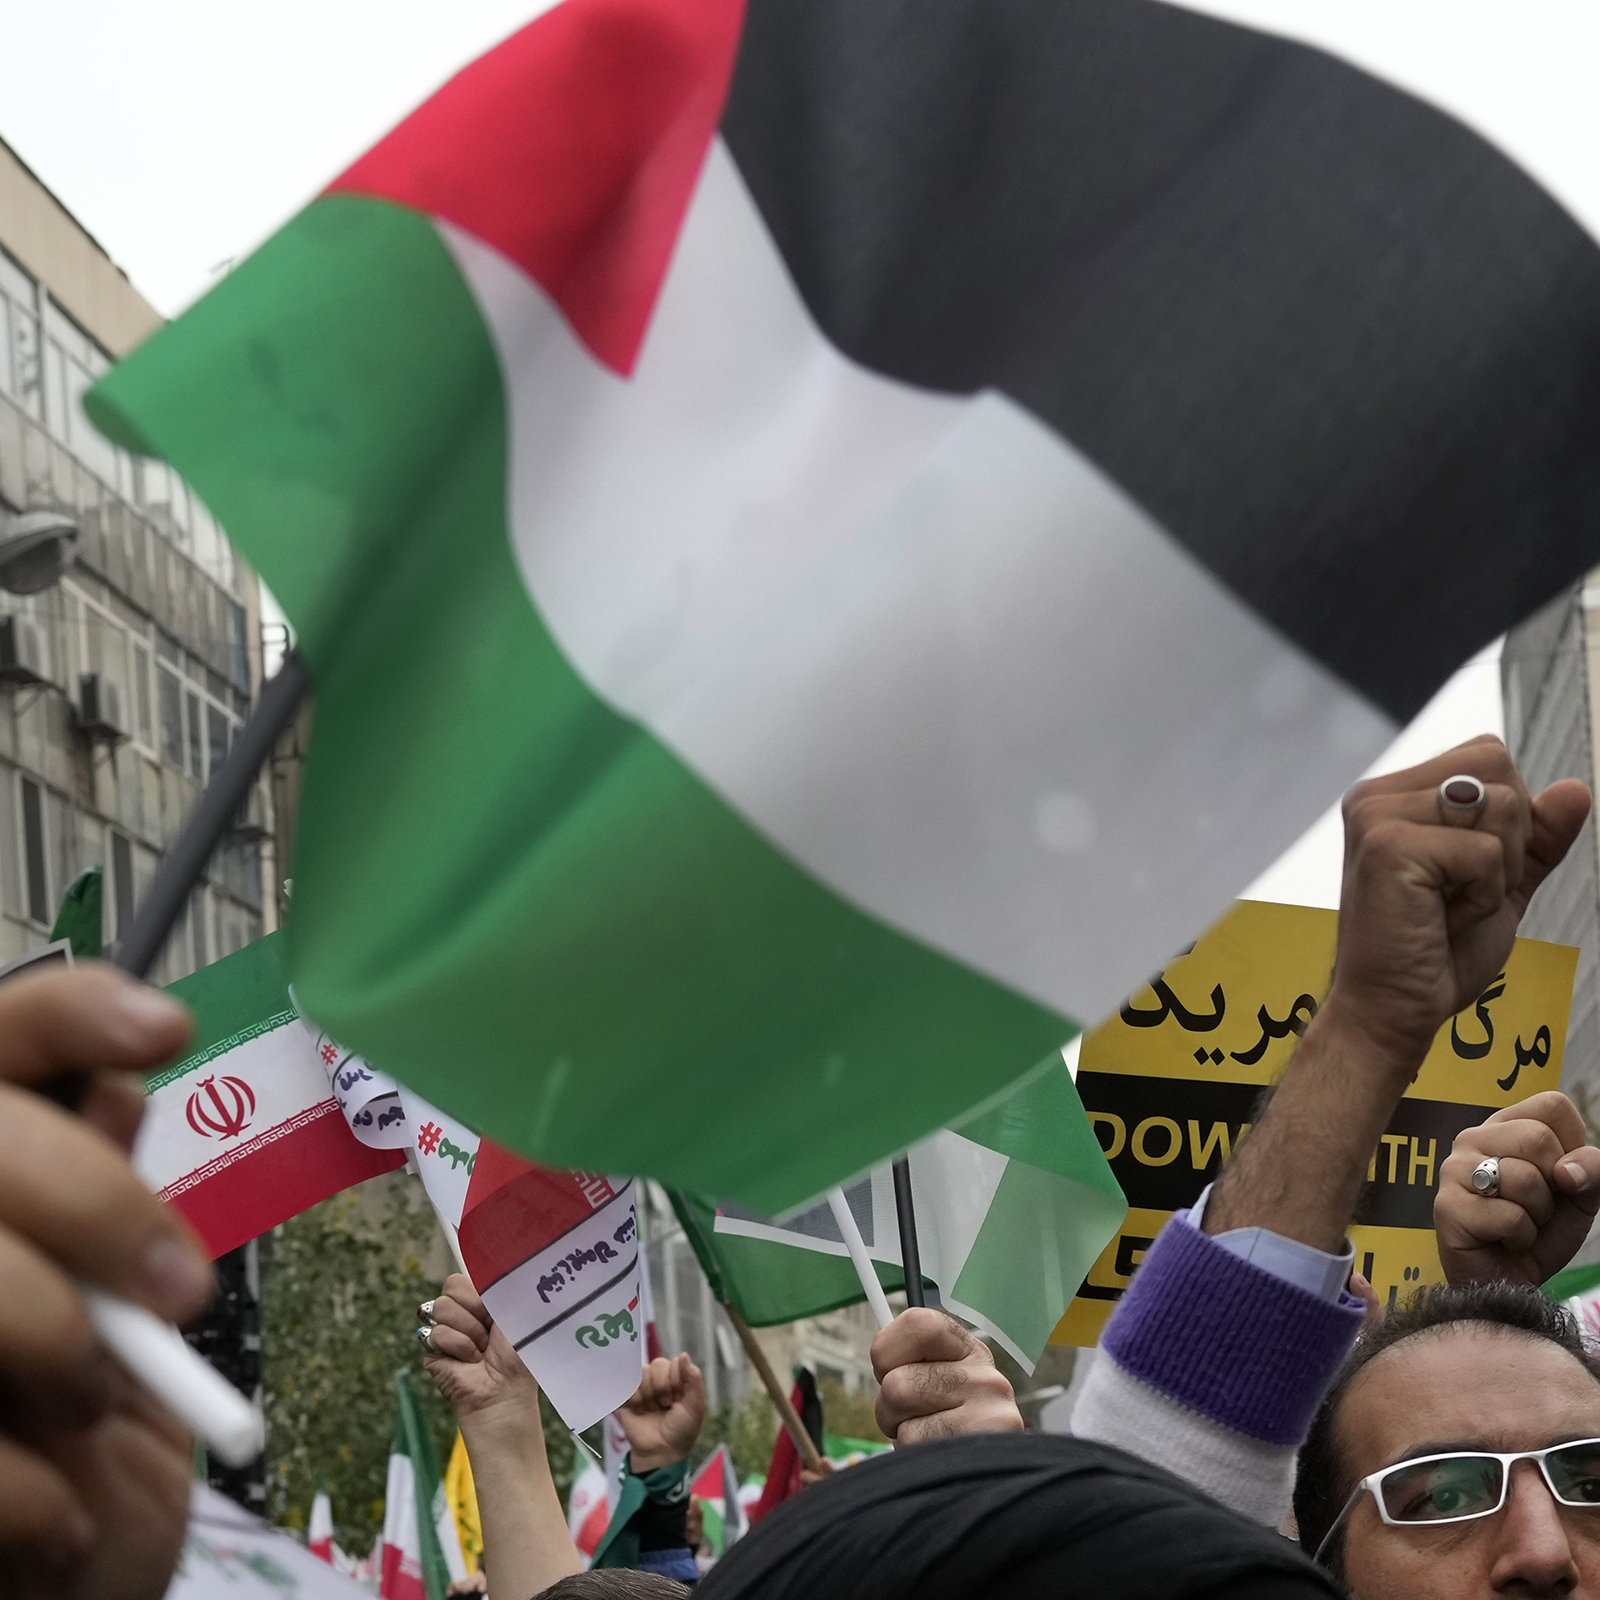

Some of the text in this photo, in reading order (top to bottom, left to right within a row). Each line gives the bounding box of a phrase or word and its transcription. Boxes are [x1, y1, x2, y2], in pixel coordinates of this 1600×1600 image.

[1451, 972, 1551, 1091] مرگ
[1086, 1111, 1437, 1187] DOW TH
